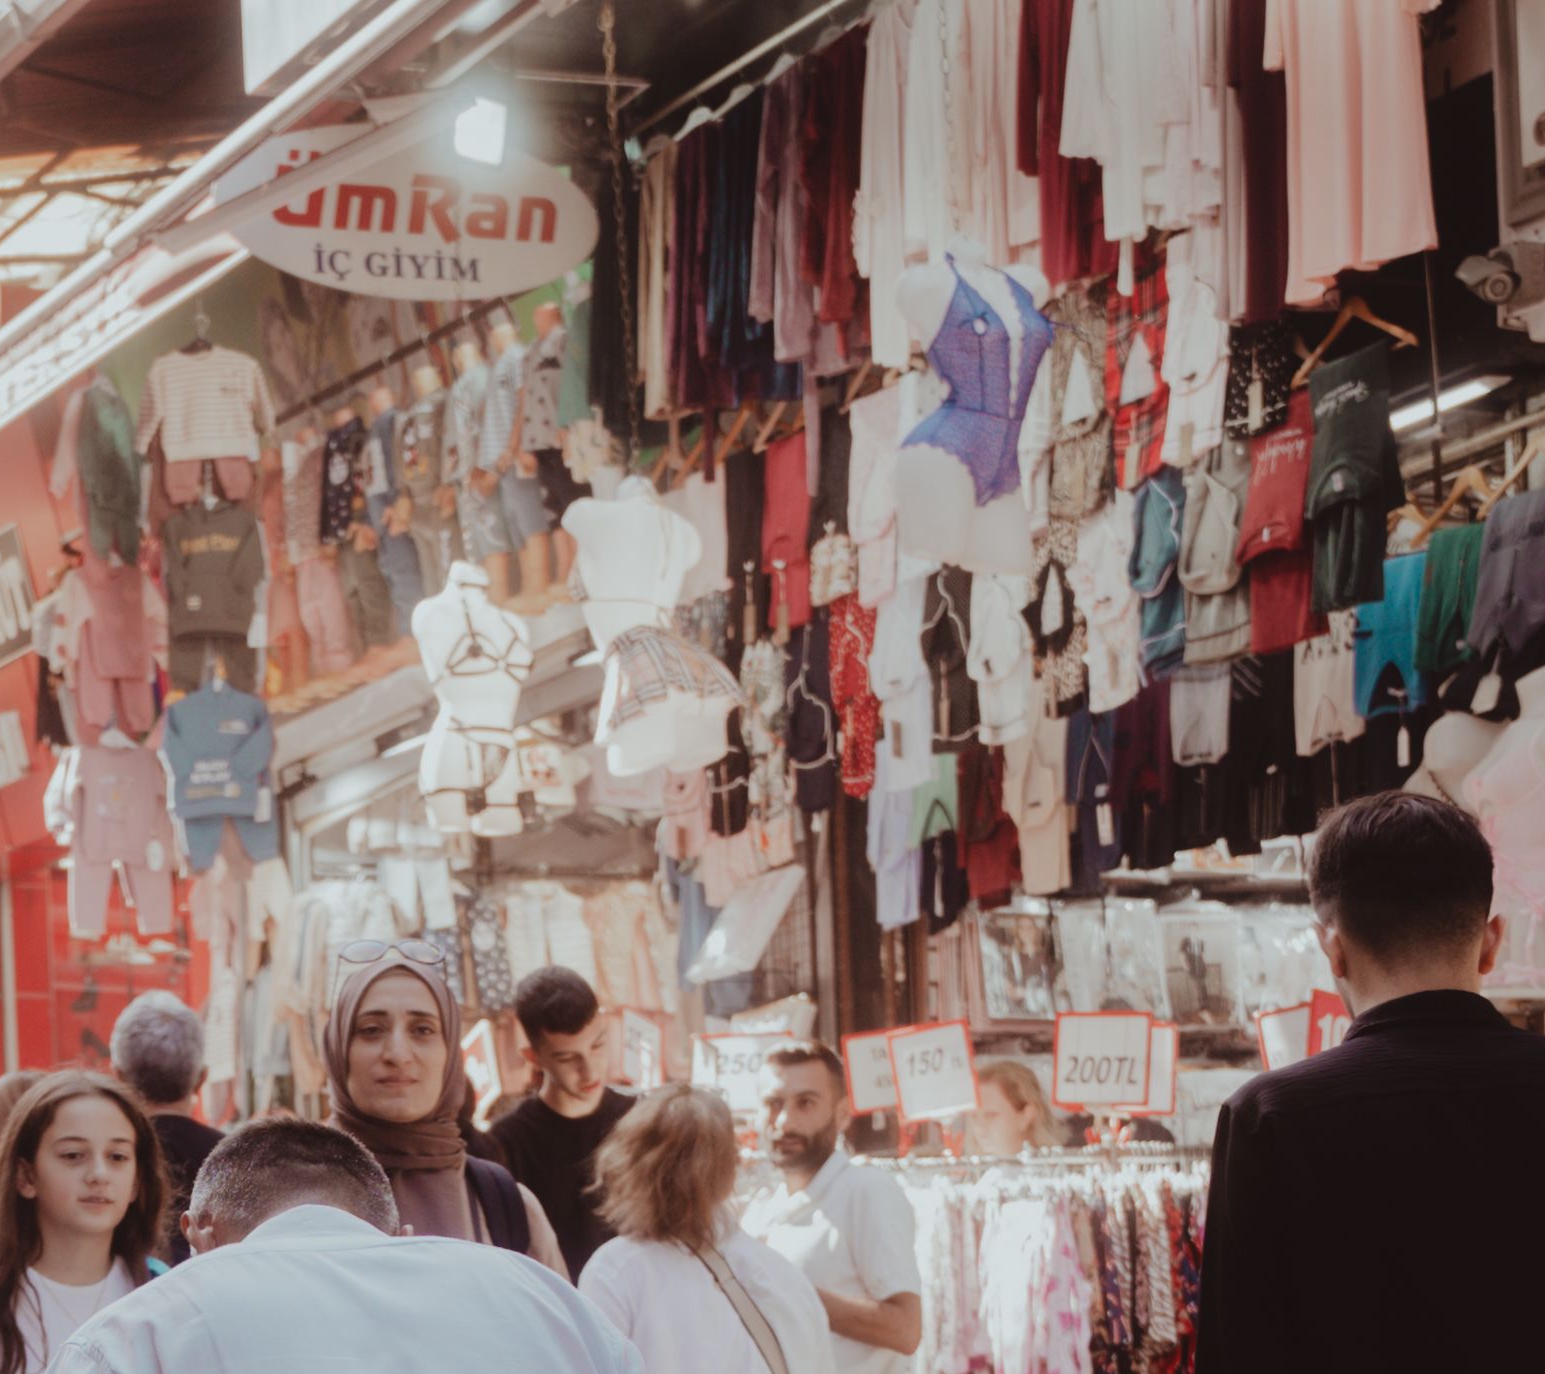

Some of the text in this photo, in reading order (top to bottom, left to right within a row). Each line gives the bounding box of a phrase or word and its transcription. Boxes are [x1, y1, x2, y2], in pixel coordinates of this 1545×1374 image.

[314, 243, 482, 283] İÇ GİYİM
[907, 1048, 944, 1078] 150
[1064, 1055, 1139, 1085] 200TL
